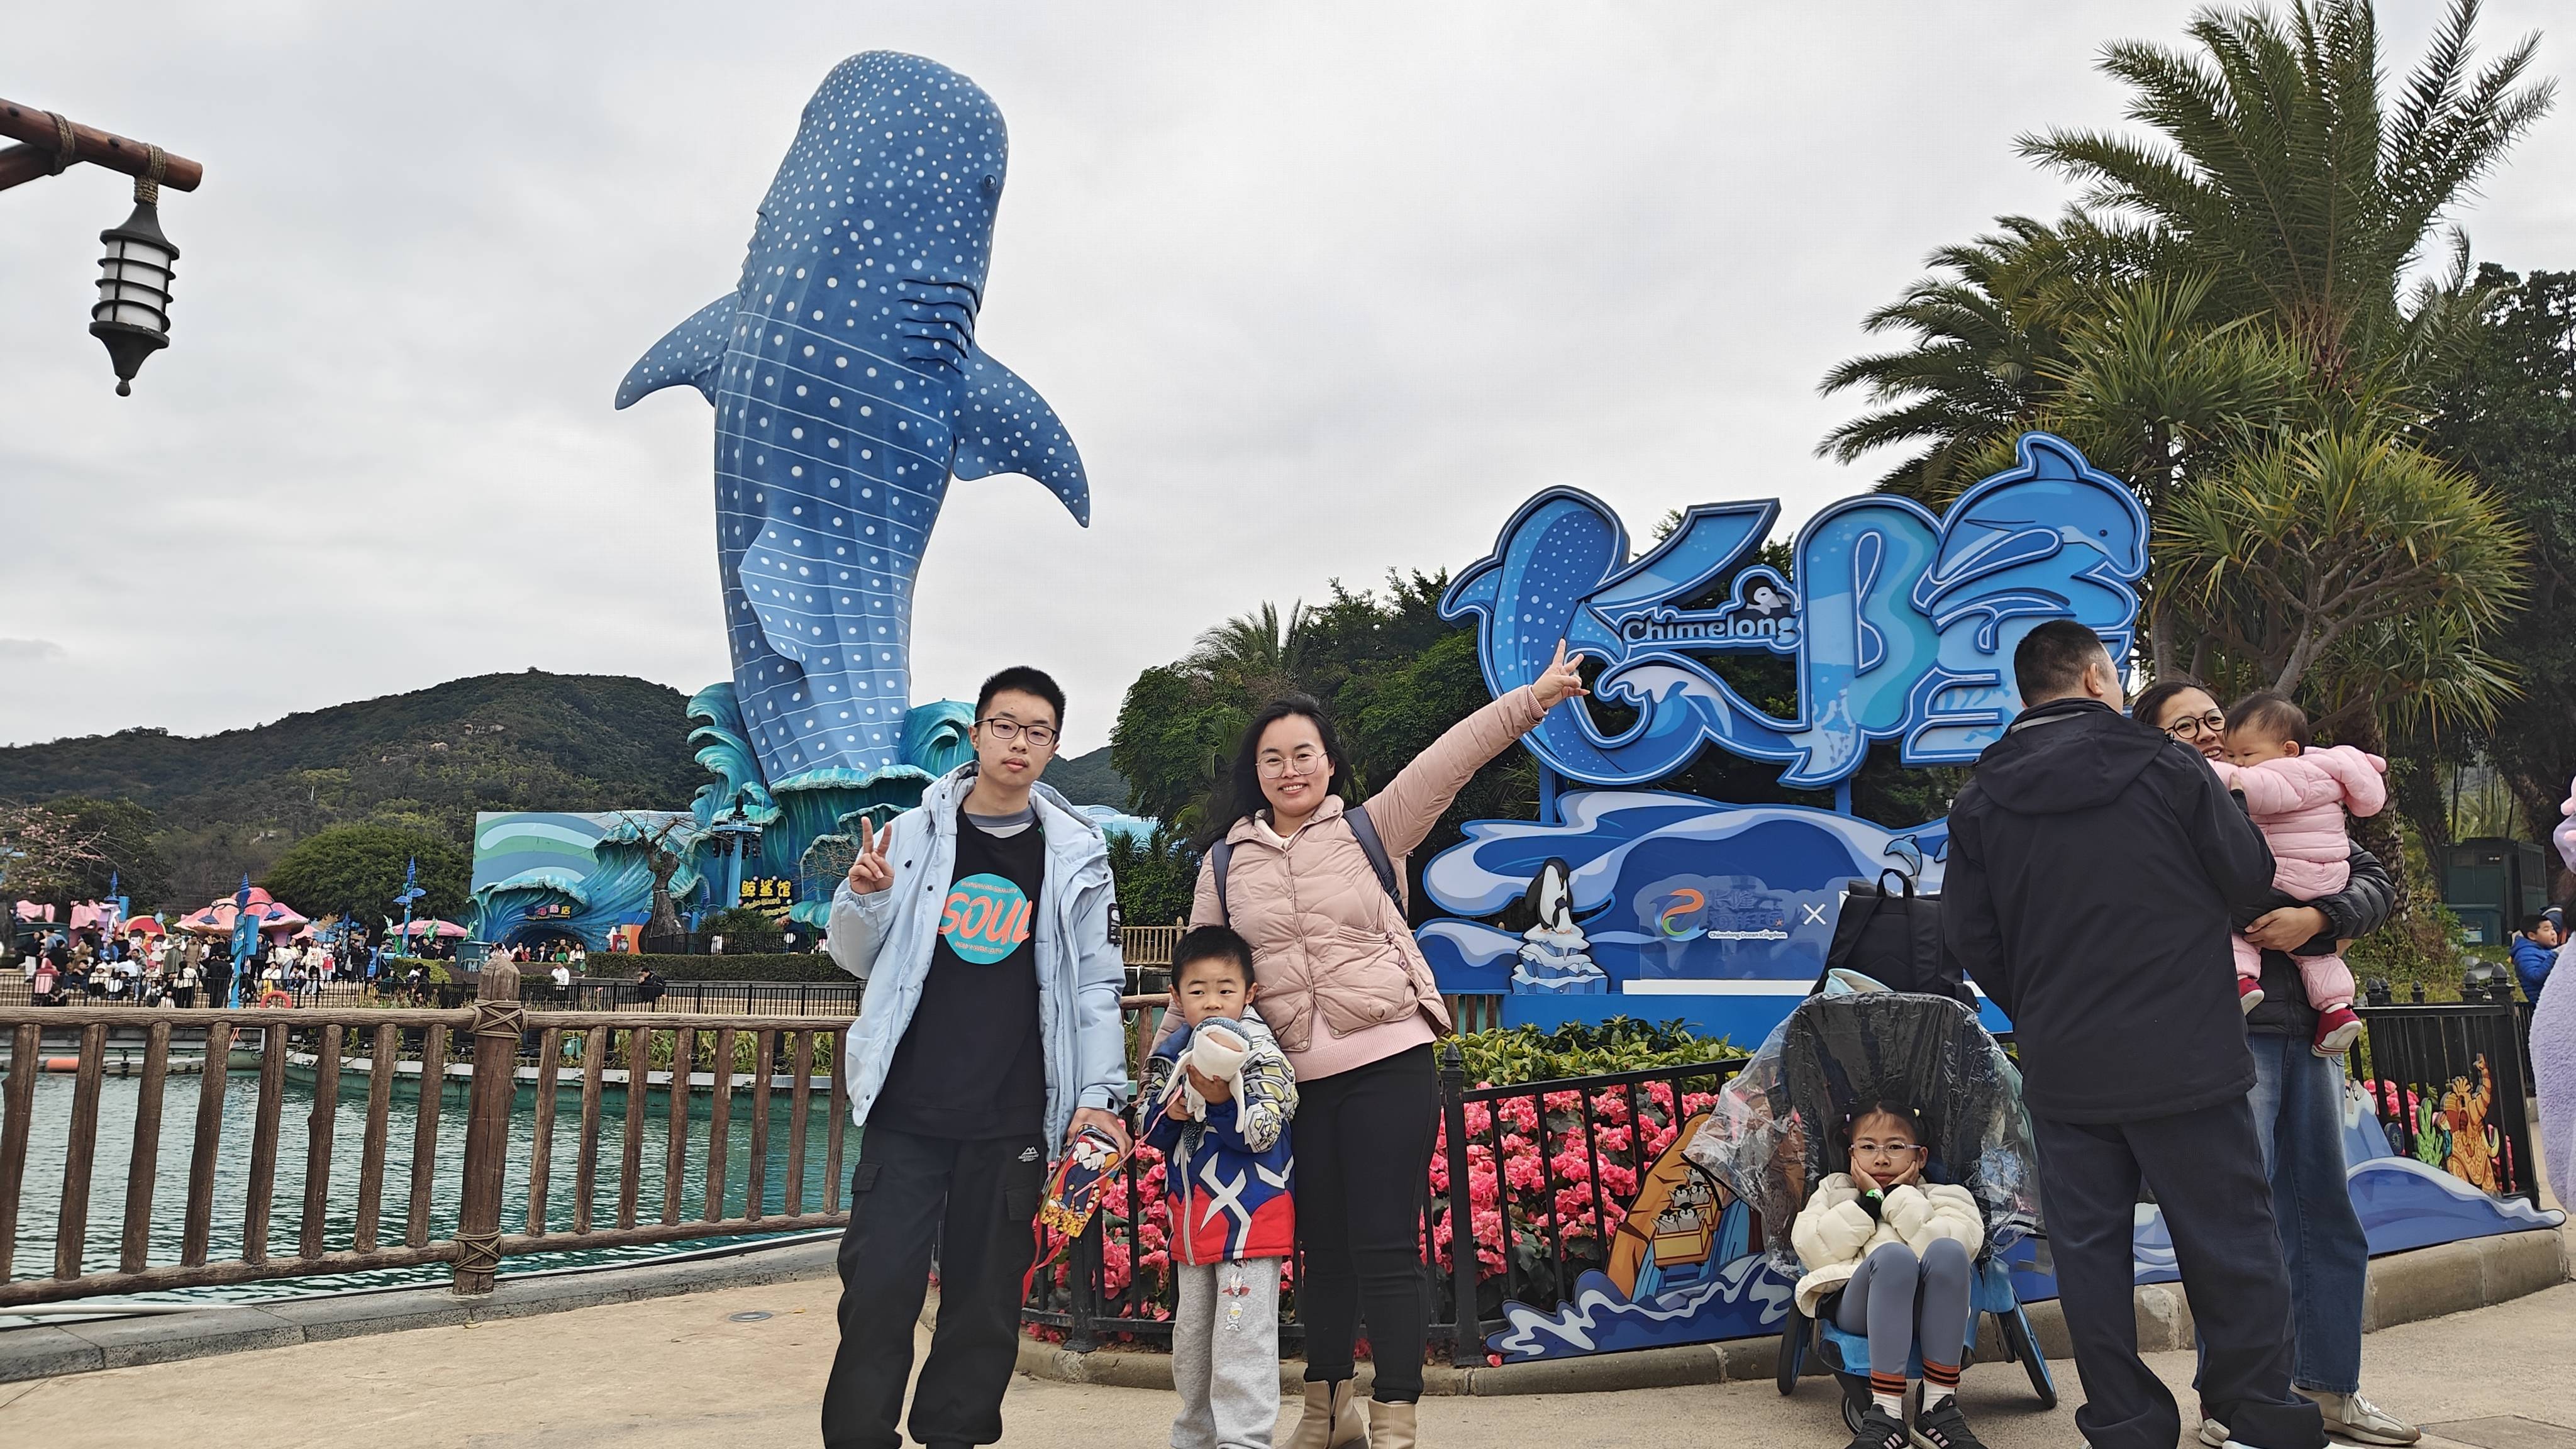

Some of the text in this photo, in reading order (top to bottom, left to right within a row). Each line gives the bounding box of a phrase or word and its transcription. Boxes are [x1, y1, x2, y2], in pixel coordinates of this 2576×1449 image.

[1623, 612, 1797, 644] Chimelong
[741, 879, 792, 897] 鲸鲨馆
[937, 892, 1033, 945] SOUL
